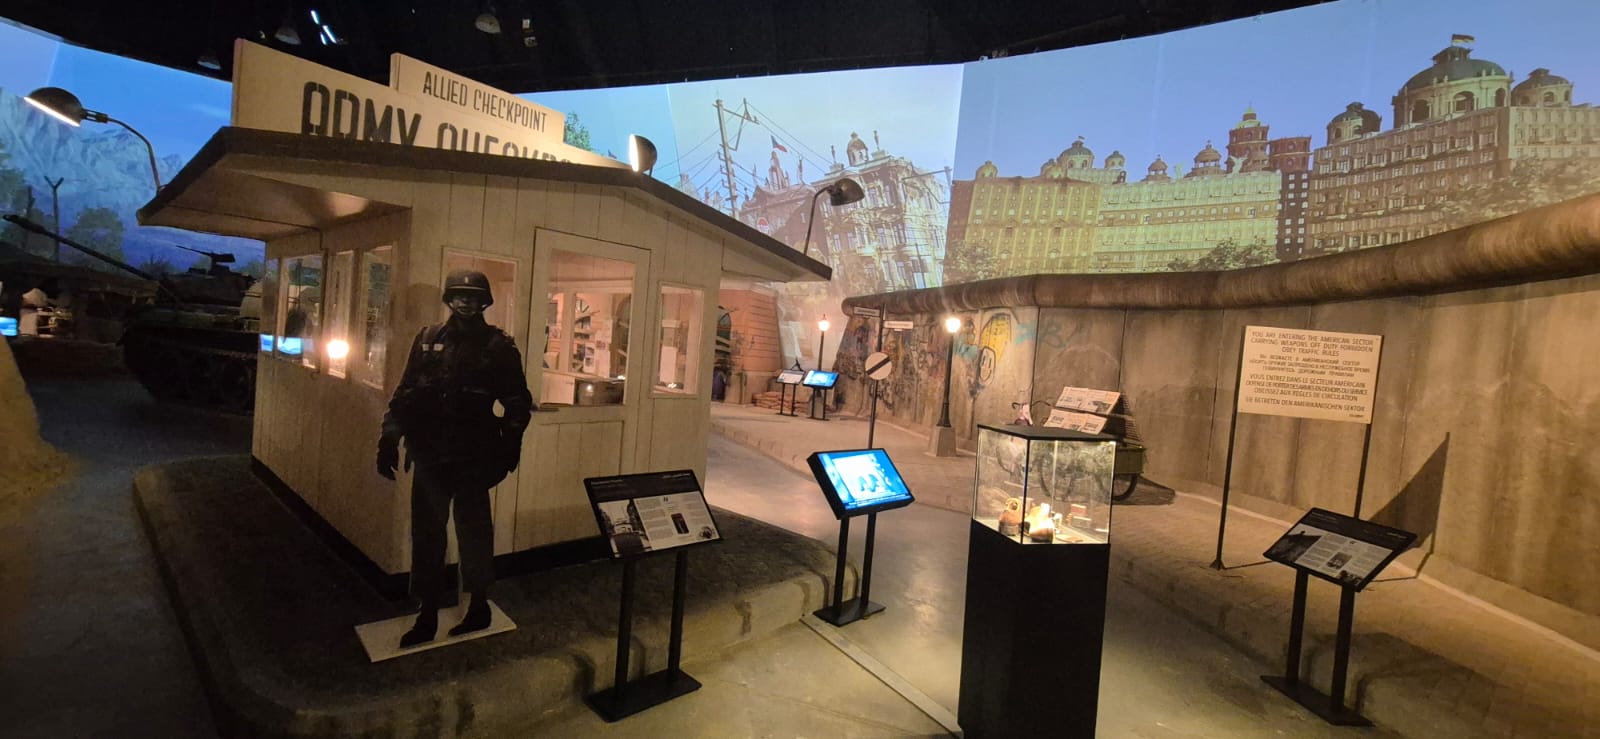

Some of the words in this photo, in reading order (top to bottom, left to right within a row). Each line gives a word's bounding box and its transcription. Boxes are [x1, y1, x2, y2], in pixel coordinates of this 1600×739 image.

[301, 81, 422, 147] ARMY
[422, 71, 468, 107] ALLIED
[474, 88, 546, 133] CHECKPOINT
[1320, 336, 1349, 344] AMERICAN
